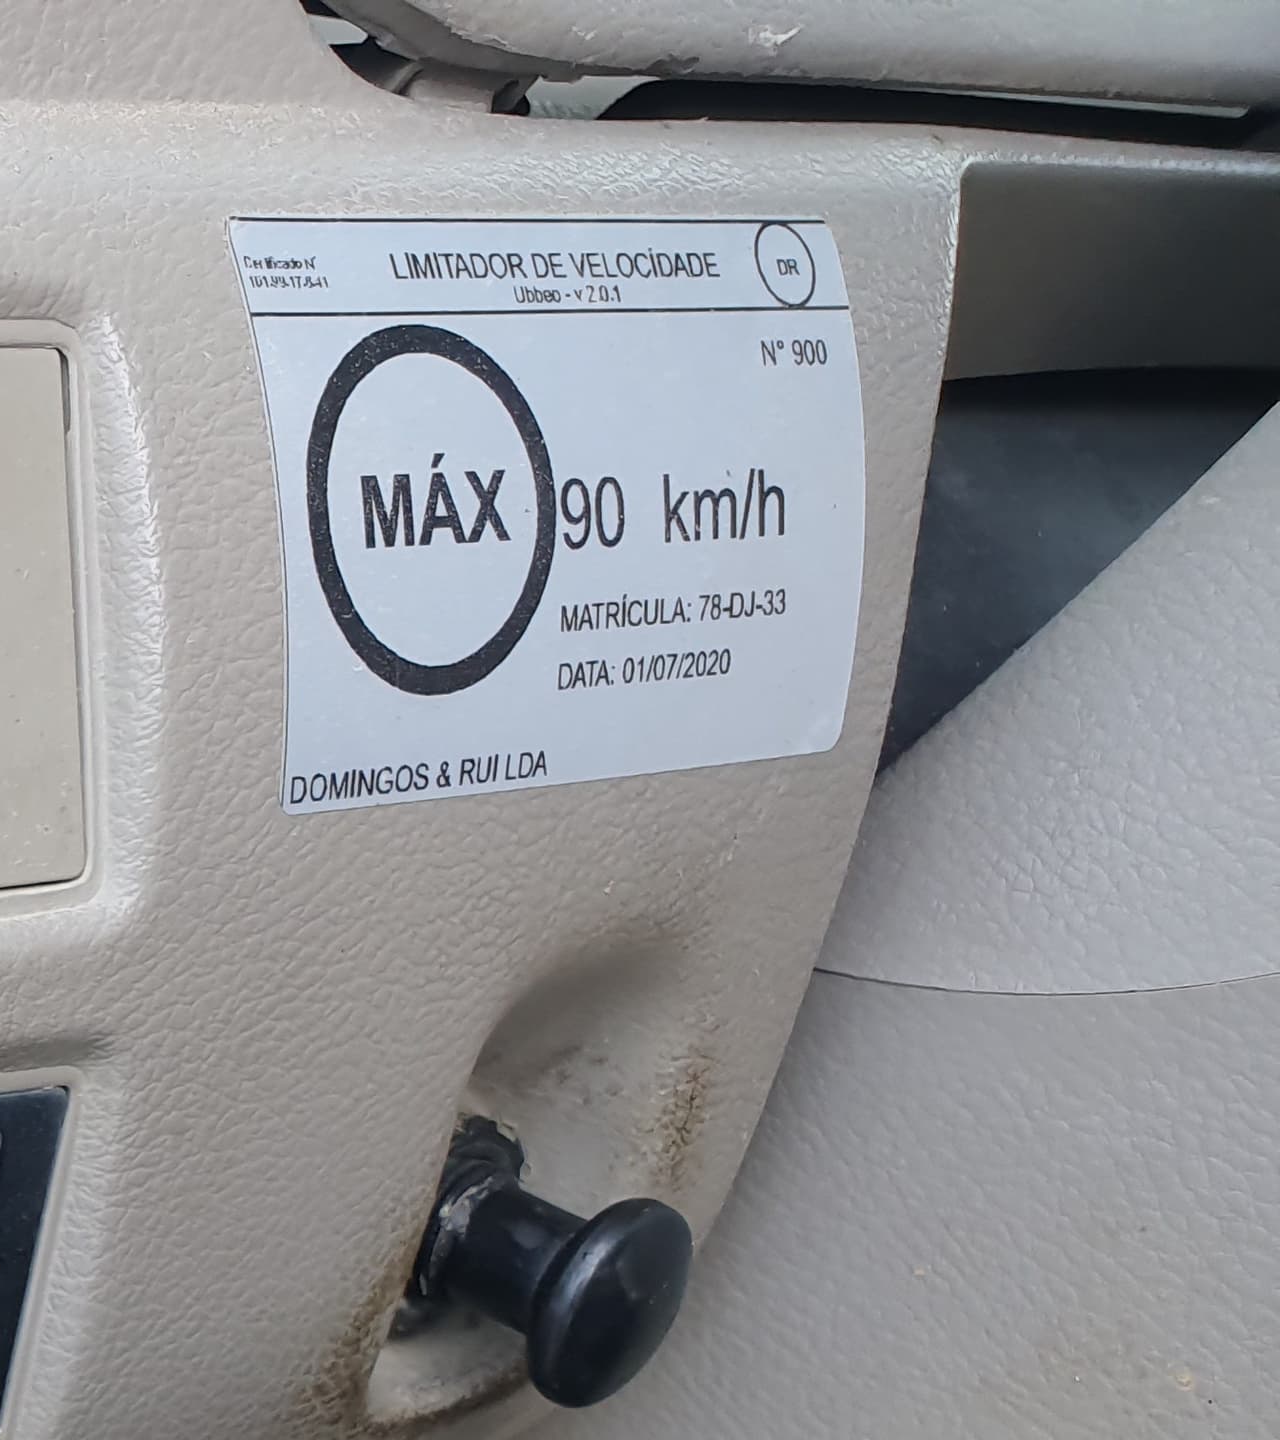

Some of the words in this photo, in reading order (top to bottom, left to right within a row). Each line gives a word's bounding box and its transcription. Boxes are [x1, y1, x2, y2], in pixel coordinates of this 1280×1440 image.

[389, 251, 528, 280] LIMITADOR
[531, 252, 567, 279] DE
[776, 258, 800, 276] DR
[791, 339, 828, 366] 900
[360, 452, 512, 549] MÁX
[560, 476, 625, 550] 90
[663, 468, 785, 543] km/h
[560, 593, 692, 633] MATRÍCULA:
[698, 588, 787, 622] 78-DJ-33
[557, 659, 616, 690] DATA:
[622, 648, 732, 684] 01/07/2020
[289, 763, 430, 804] DOMINGOS
[436, 761, 452, 789] &
[458, 754, 499, 787] RUI
[504, 750, 548, 781] LDA
